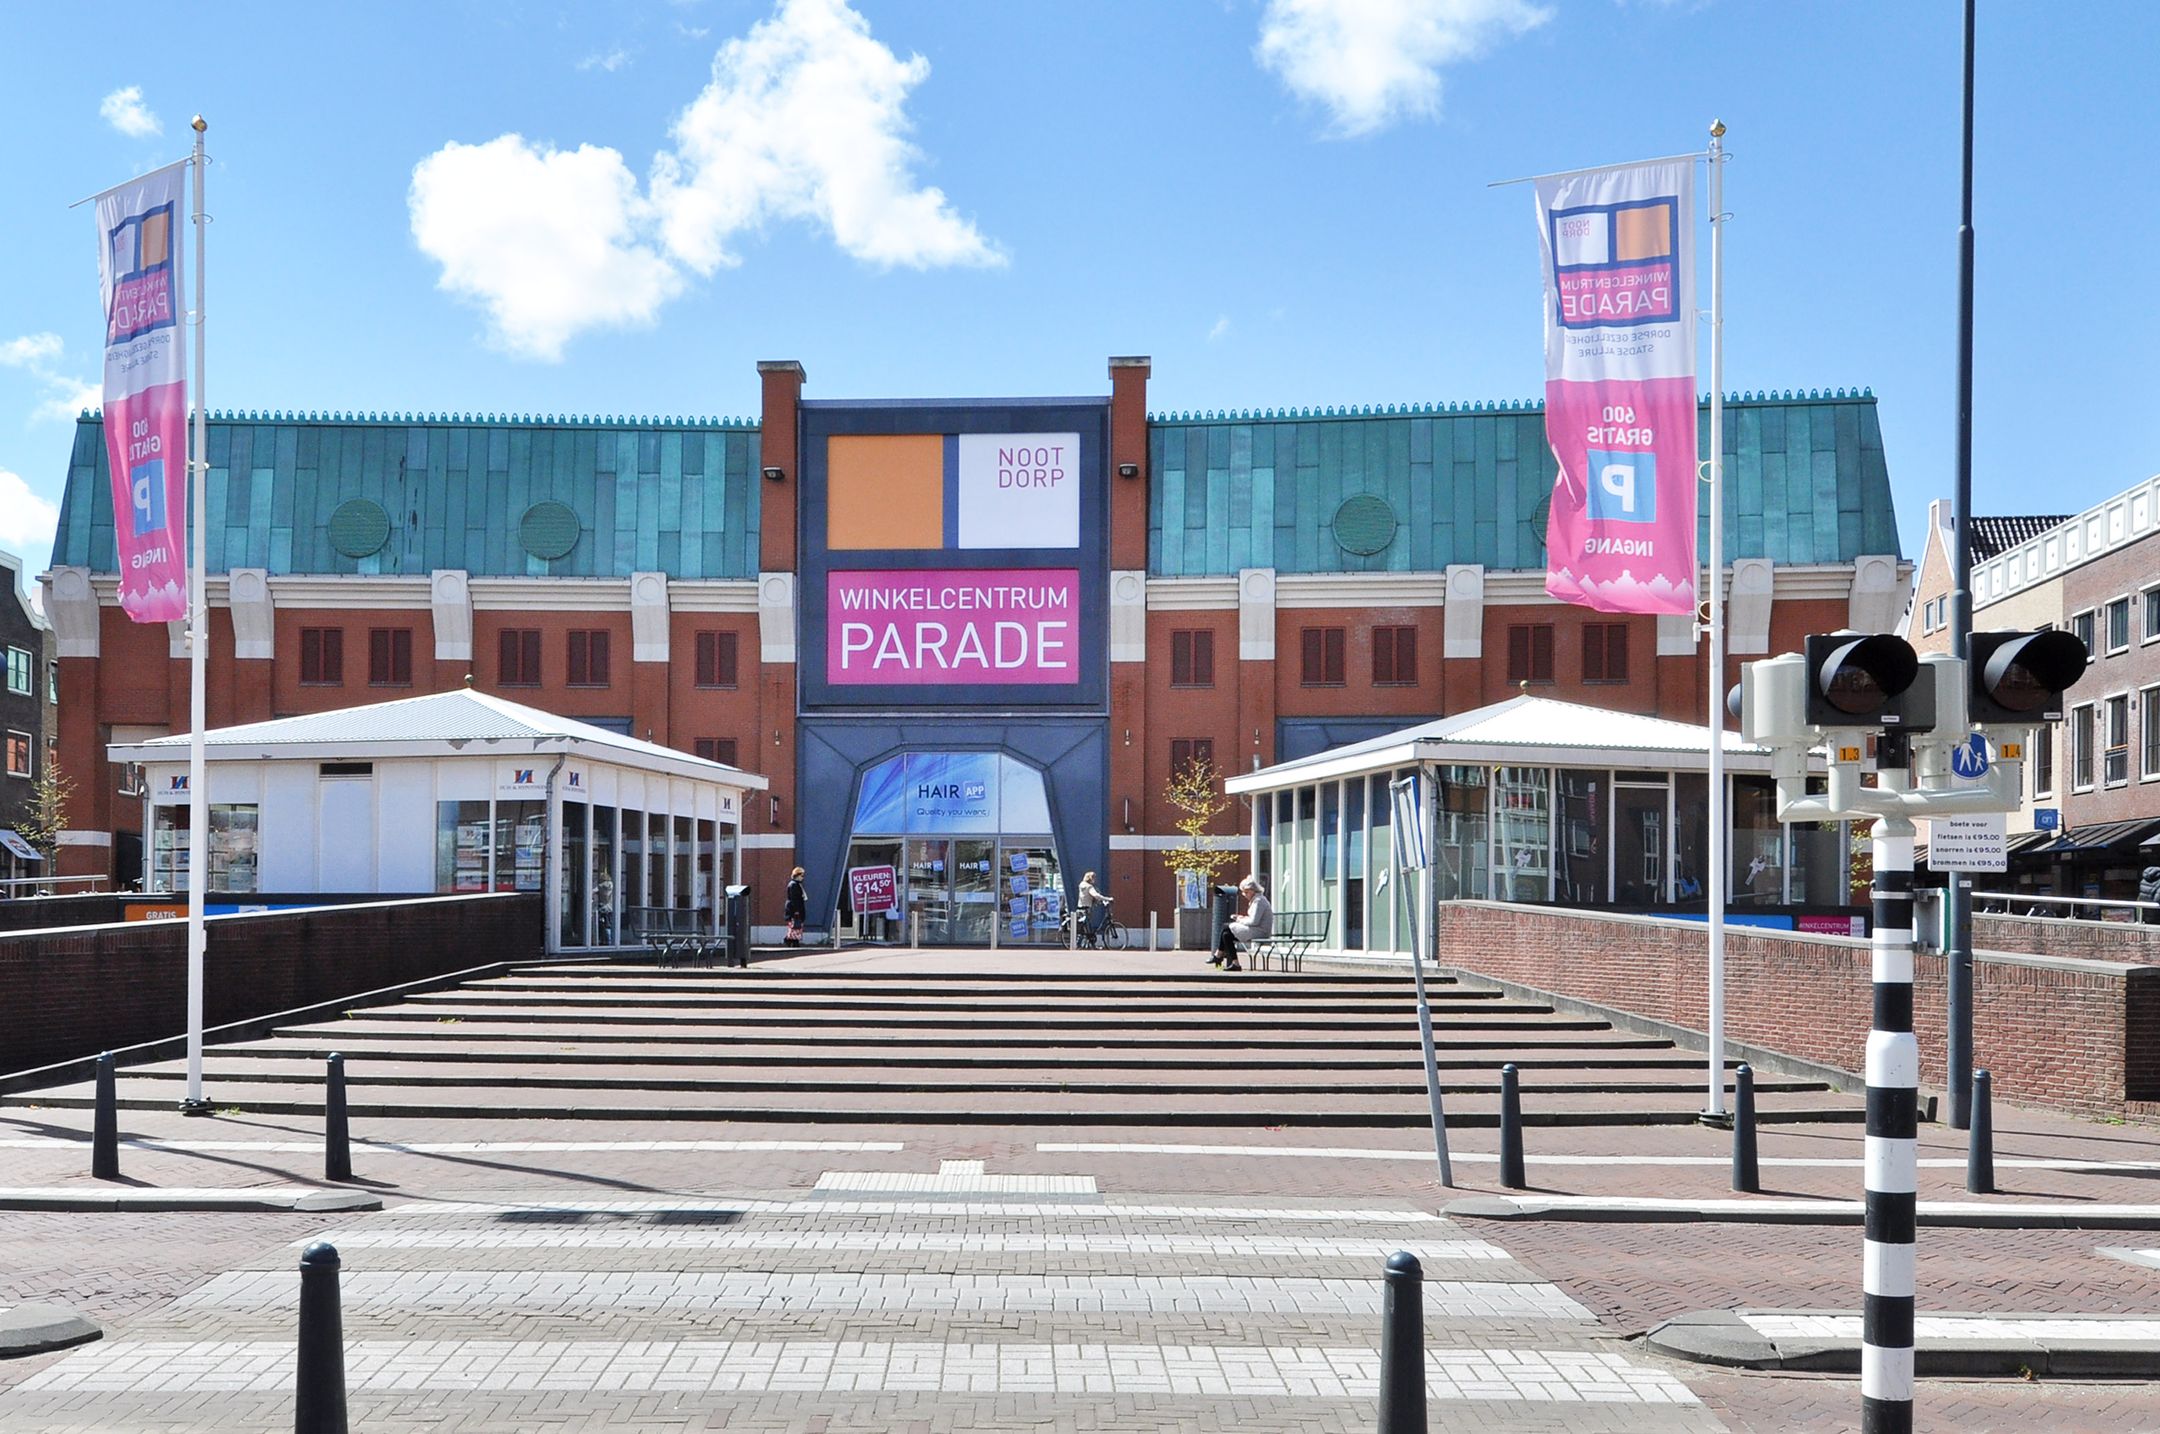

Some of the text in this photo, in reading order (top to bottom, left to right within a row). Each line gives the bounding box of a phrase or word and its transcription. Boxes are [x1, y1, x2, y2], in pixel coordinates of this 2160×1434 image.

[999, 447, 1064, 467] NOOT
[999, 469, 1065, 488] DORP
[839, 587, 1068, 610] WINKELCENTRUM
[841, 621, 1067, 669] PARADE
[919, 785, 984, 798] HAIR APP
[913, 861, 933, 869] HAIR
[959, 861, 979, 869] HAIR
[146, 911, 177, 921] GRATIS
